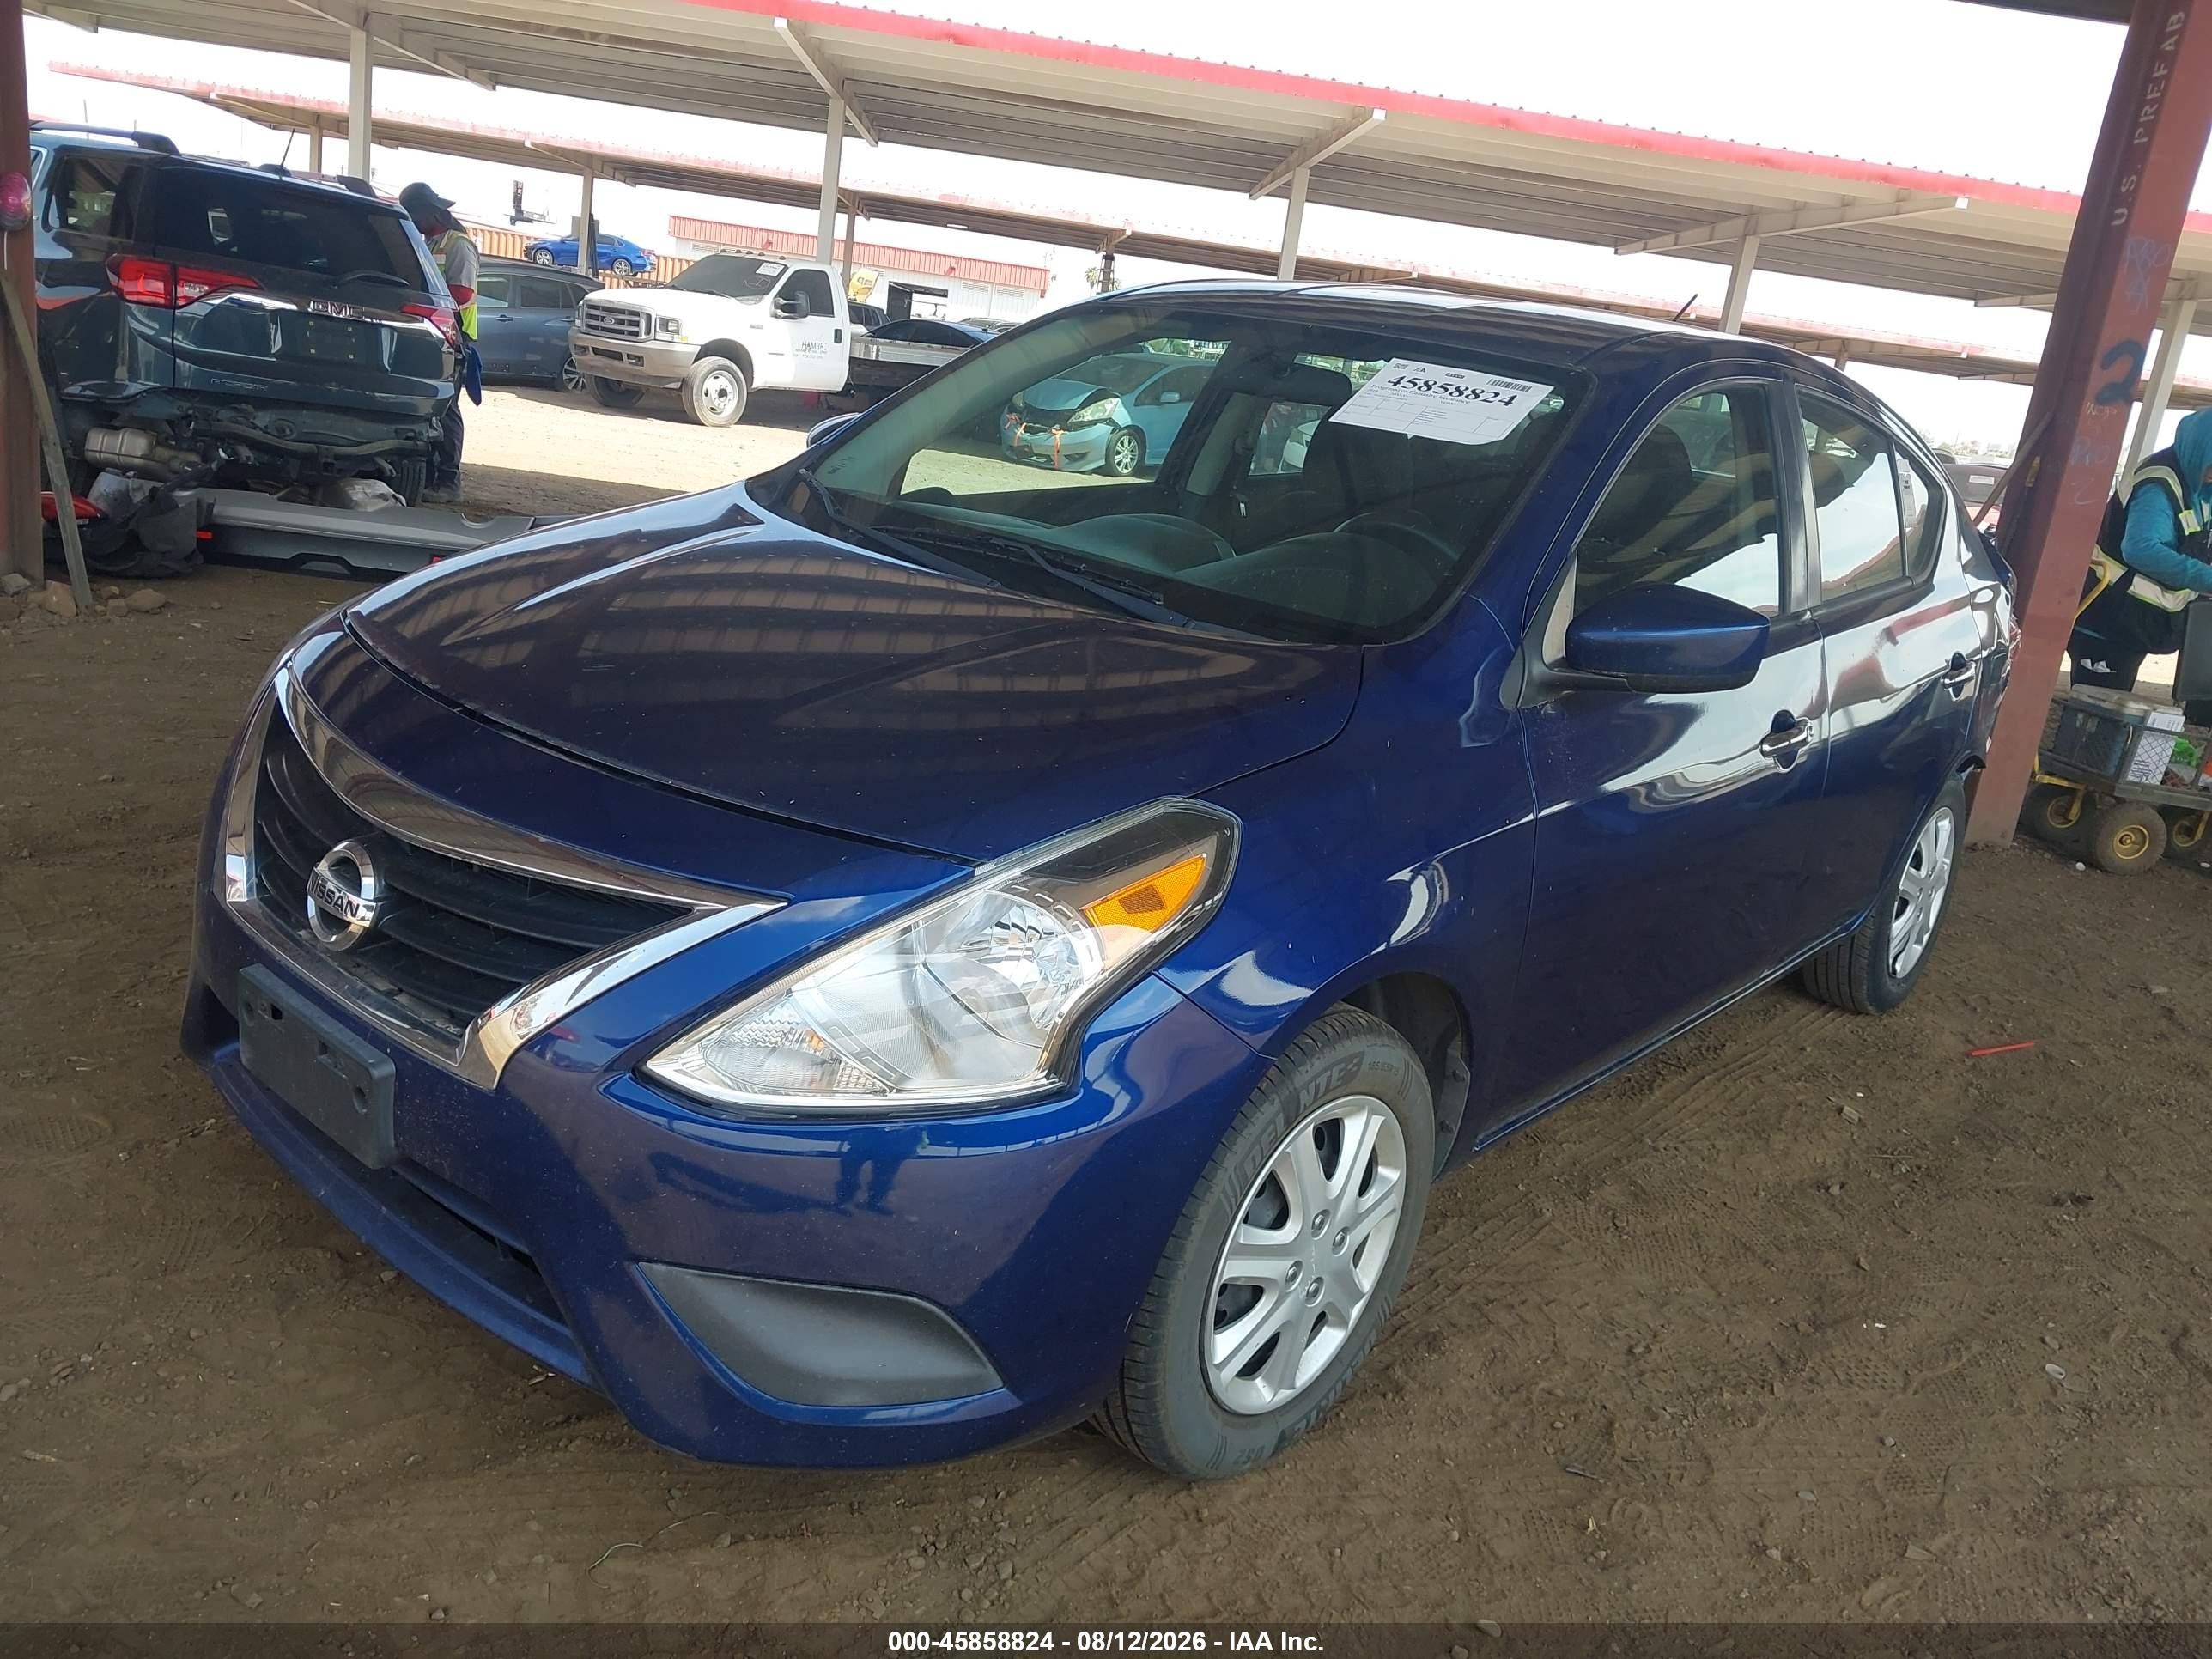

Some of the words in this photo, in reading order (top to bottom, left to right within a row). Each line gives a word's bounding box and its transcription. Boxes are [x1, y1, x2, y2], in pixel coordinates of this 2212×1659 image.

[1387, 375, 1518, 407] 45858824
[2094, 339, 2145, 406] 2
[307, 867, 361, 919] NISSAN
